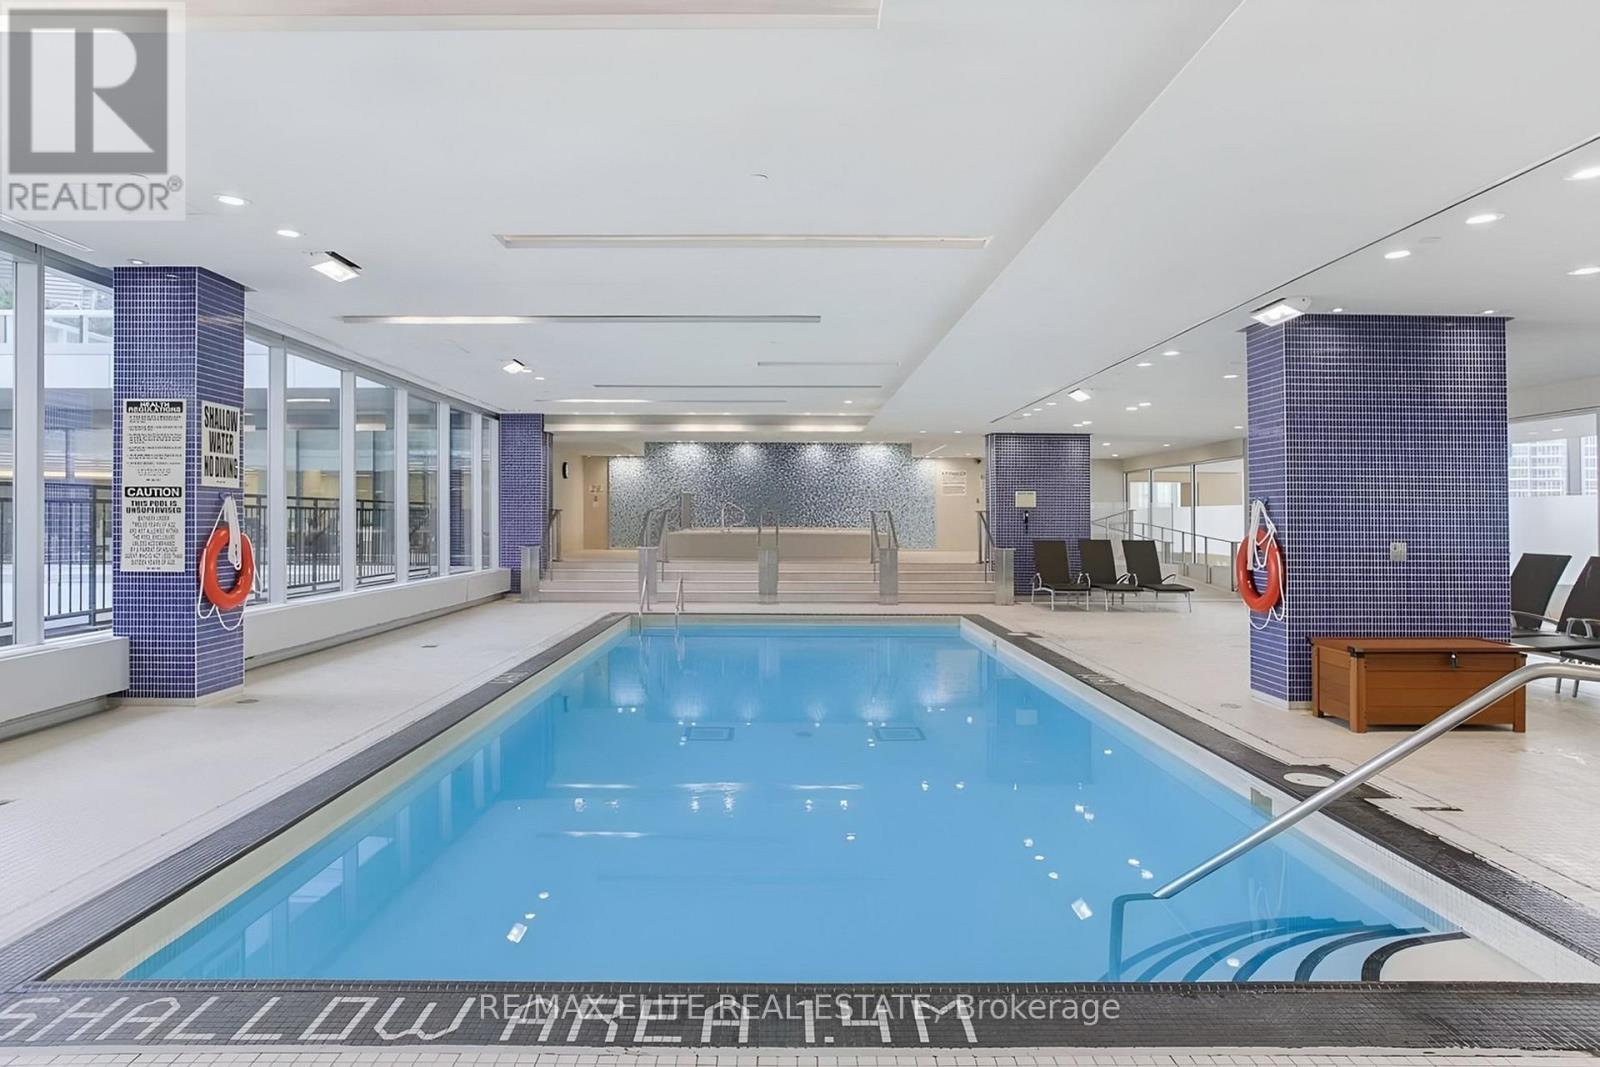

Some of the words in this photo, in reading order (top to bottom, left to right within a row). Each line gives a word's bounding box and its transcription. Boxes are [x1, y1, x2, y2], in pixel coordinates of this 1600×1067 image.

[204, 405, 239, 432] SHALLOW
[208, 430, 234, 455] WATER
[204, 455, 214, 477] NO
[215, 456, 238, 479] DIVING
[127, 487, 180, 497] CAUTION
[0, 997, 476, 1041] SHALLOW
[499, 998, 750, 1043] AREA
